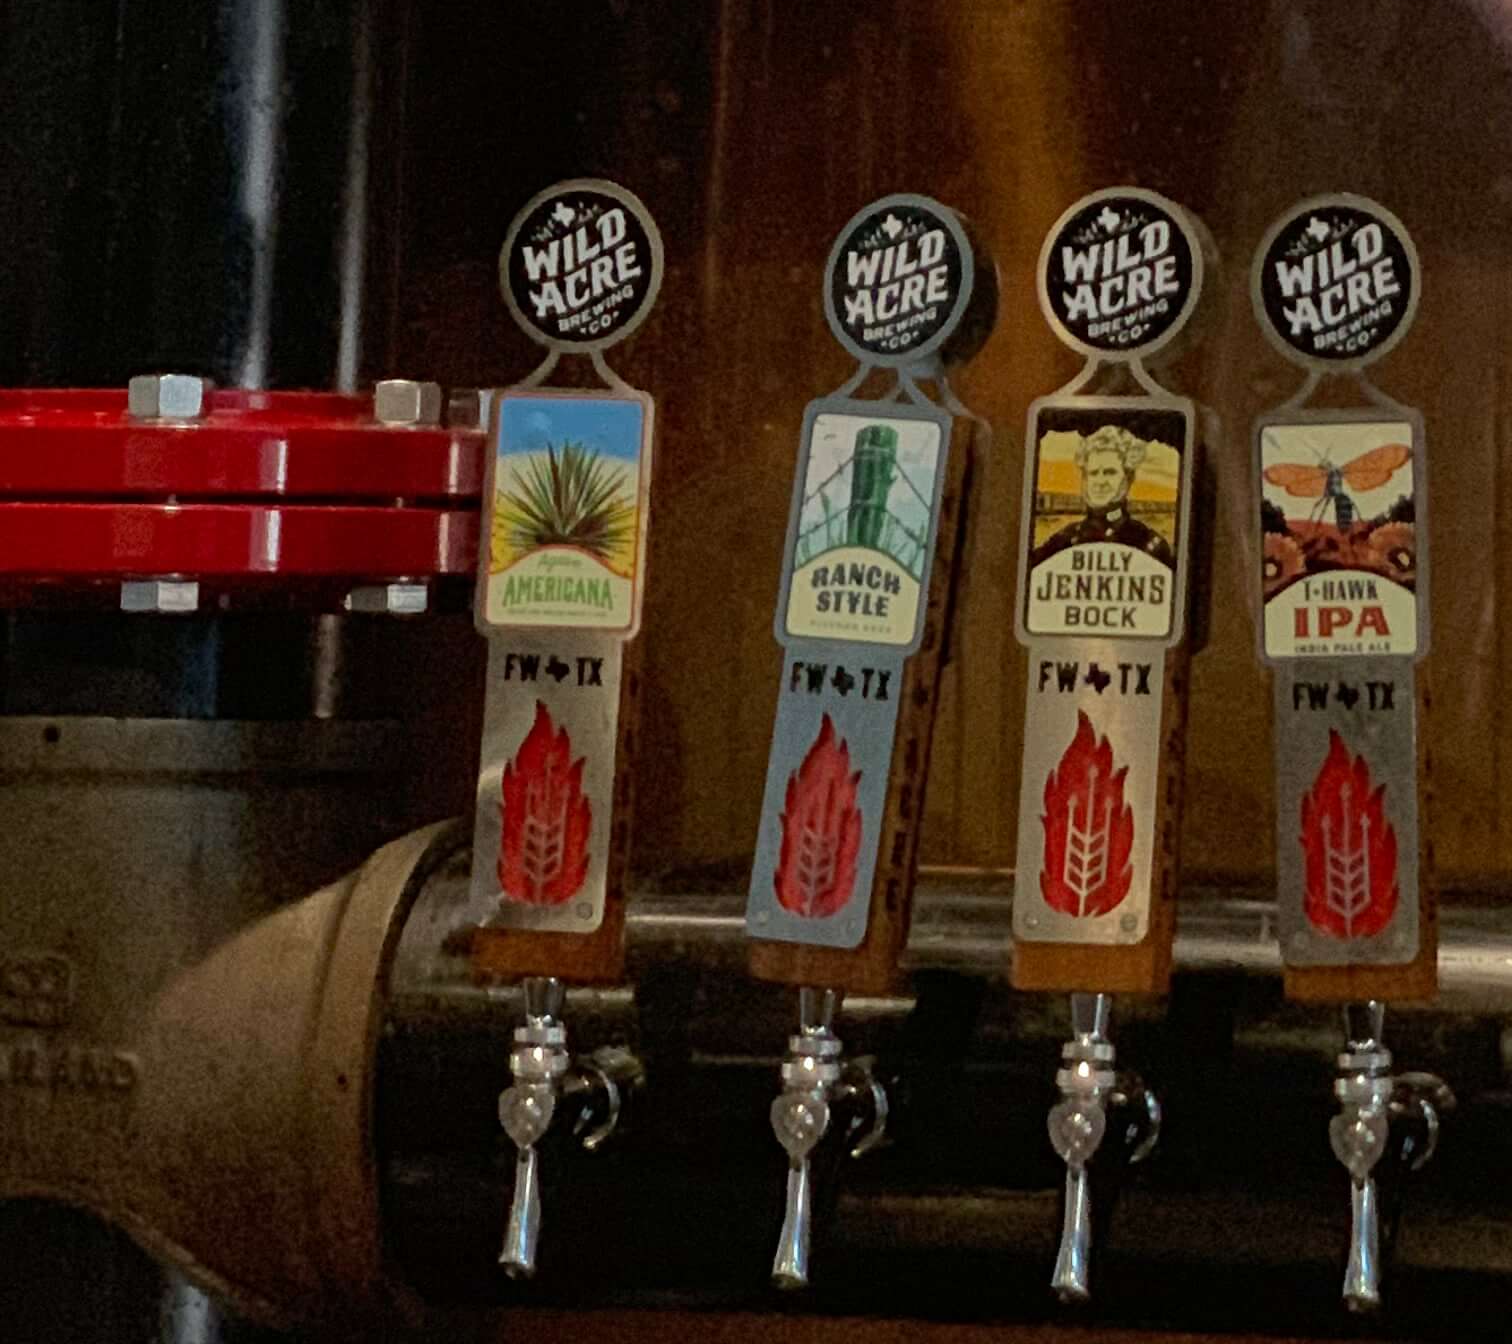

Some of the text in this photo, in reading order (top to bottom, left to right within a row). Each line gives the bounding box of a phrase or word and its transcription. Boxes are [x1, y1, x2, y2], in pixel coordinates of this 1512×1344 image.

[522, 210, 629, 283] WILD
[844, 229, 946, 288] WILD
[1061, 217, 1172, 287] WILD
[1274, 222, 1386, 296] WILD
[529, 244, 642, 318] ACRE
[842, 264, 952, 325] ACRE
[1064, 256, 1180, 322] ACRE
[1282, 257, 1399, 336] ACRE
[558, 285, 636, 336] BREWING
[862, 306, 940, 343] BREWING
[1087, 296, 1170, 340] BREWING
[1313, 302, 1394, 352] BREWING
[810, 562, 902, 596] RANCH
[1071, 550, 1134, 573] BILLY
[502, 574, 614, 612] AMERICANA
[816, 589, 890, 619] STYLE
[1036, 571, 1166, 605] JENKINS
[1064, 605, 1137, 629] BOCK
[1293, 605, 1391, 639] IPA
[1367, 641, 1391, 654] ALE
[504, 652, 605, 688] FW TX
[791, 662, 892, 700] FW TX
[1038, 662, 1151, 696] FW TX
[1292, 680, 1395, 711] FW TX
